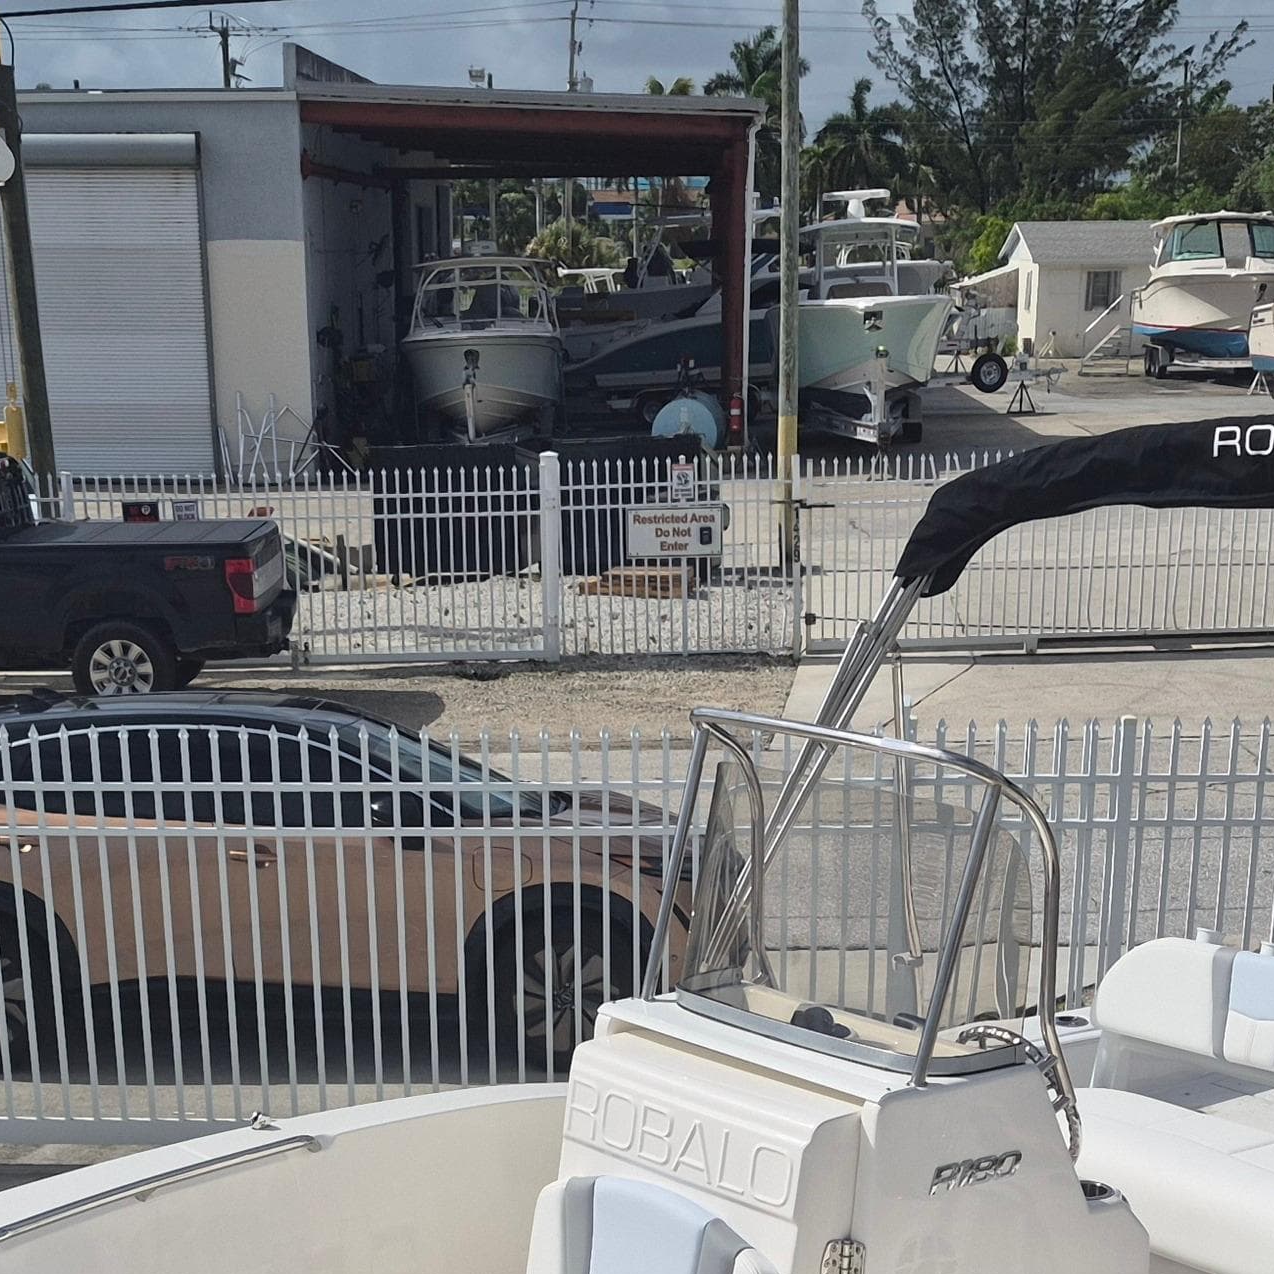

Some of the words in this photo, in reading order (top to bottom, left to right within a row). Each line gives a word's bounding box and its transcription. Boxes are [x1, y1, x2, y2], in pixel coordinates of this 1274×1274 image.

[633, 513, 688, 525] Restricted
[690, 513, 715, 524] Area
[655, 527, 670, 537] Do
[672, 527, 692, 537] Not
[660, 541, 689, 552] Enter
[793, 506, 801, 563] 1429
[567, 1079, 794, 1207] ROBALO
[929, 1150, 1022, 1196] R180
